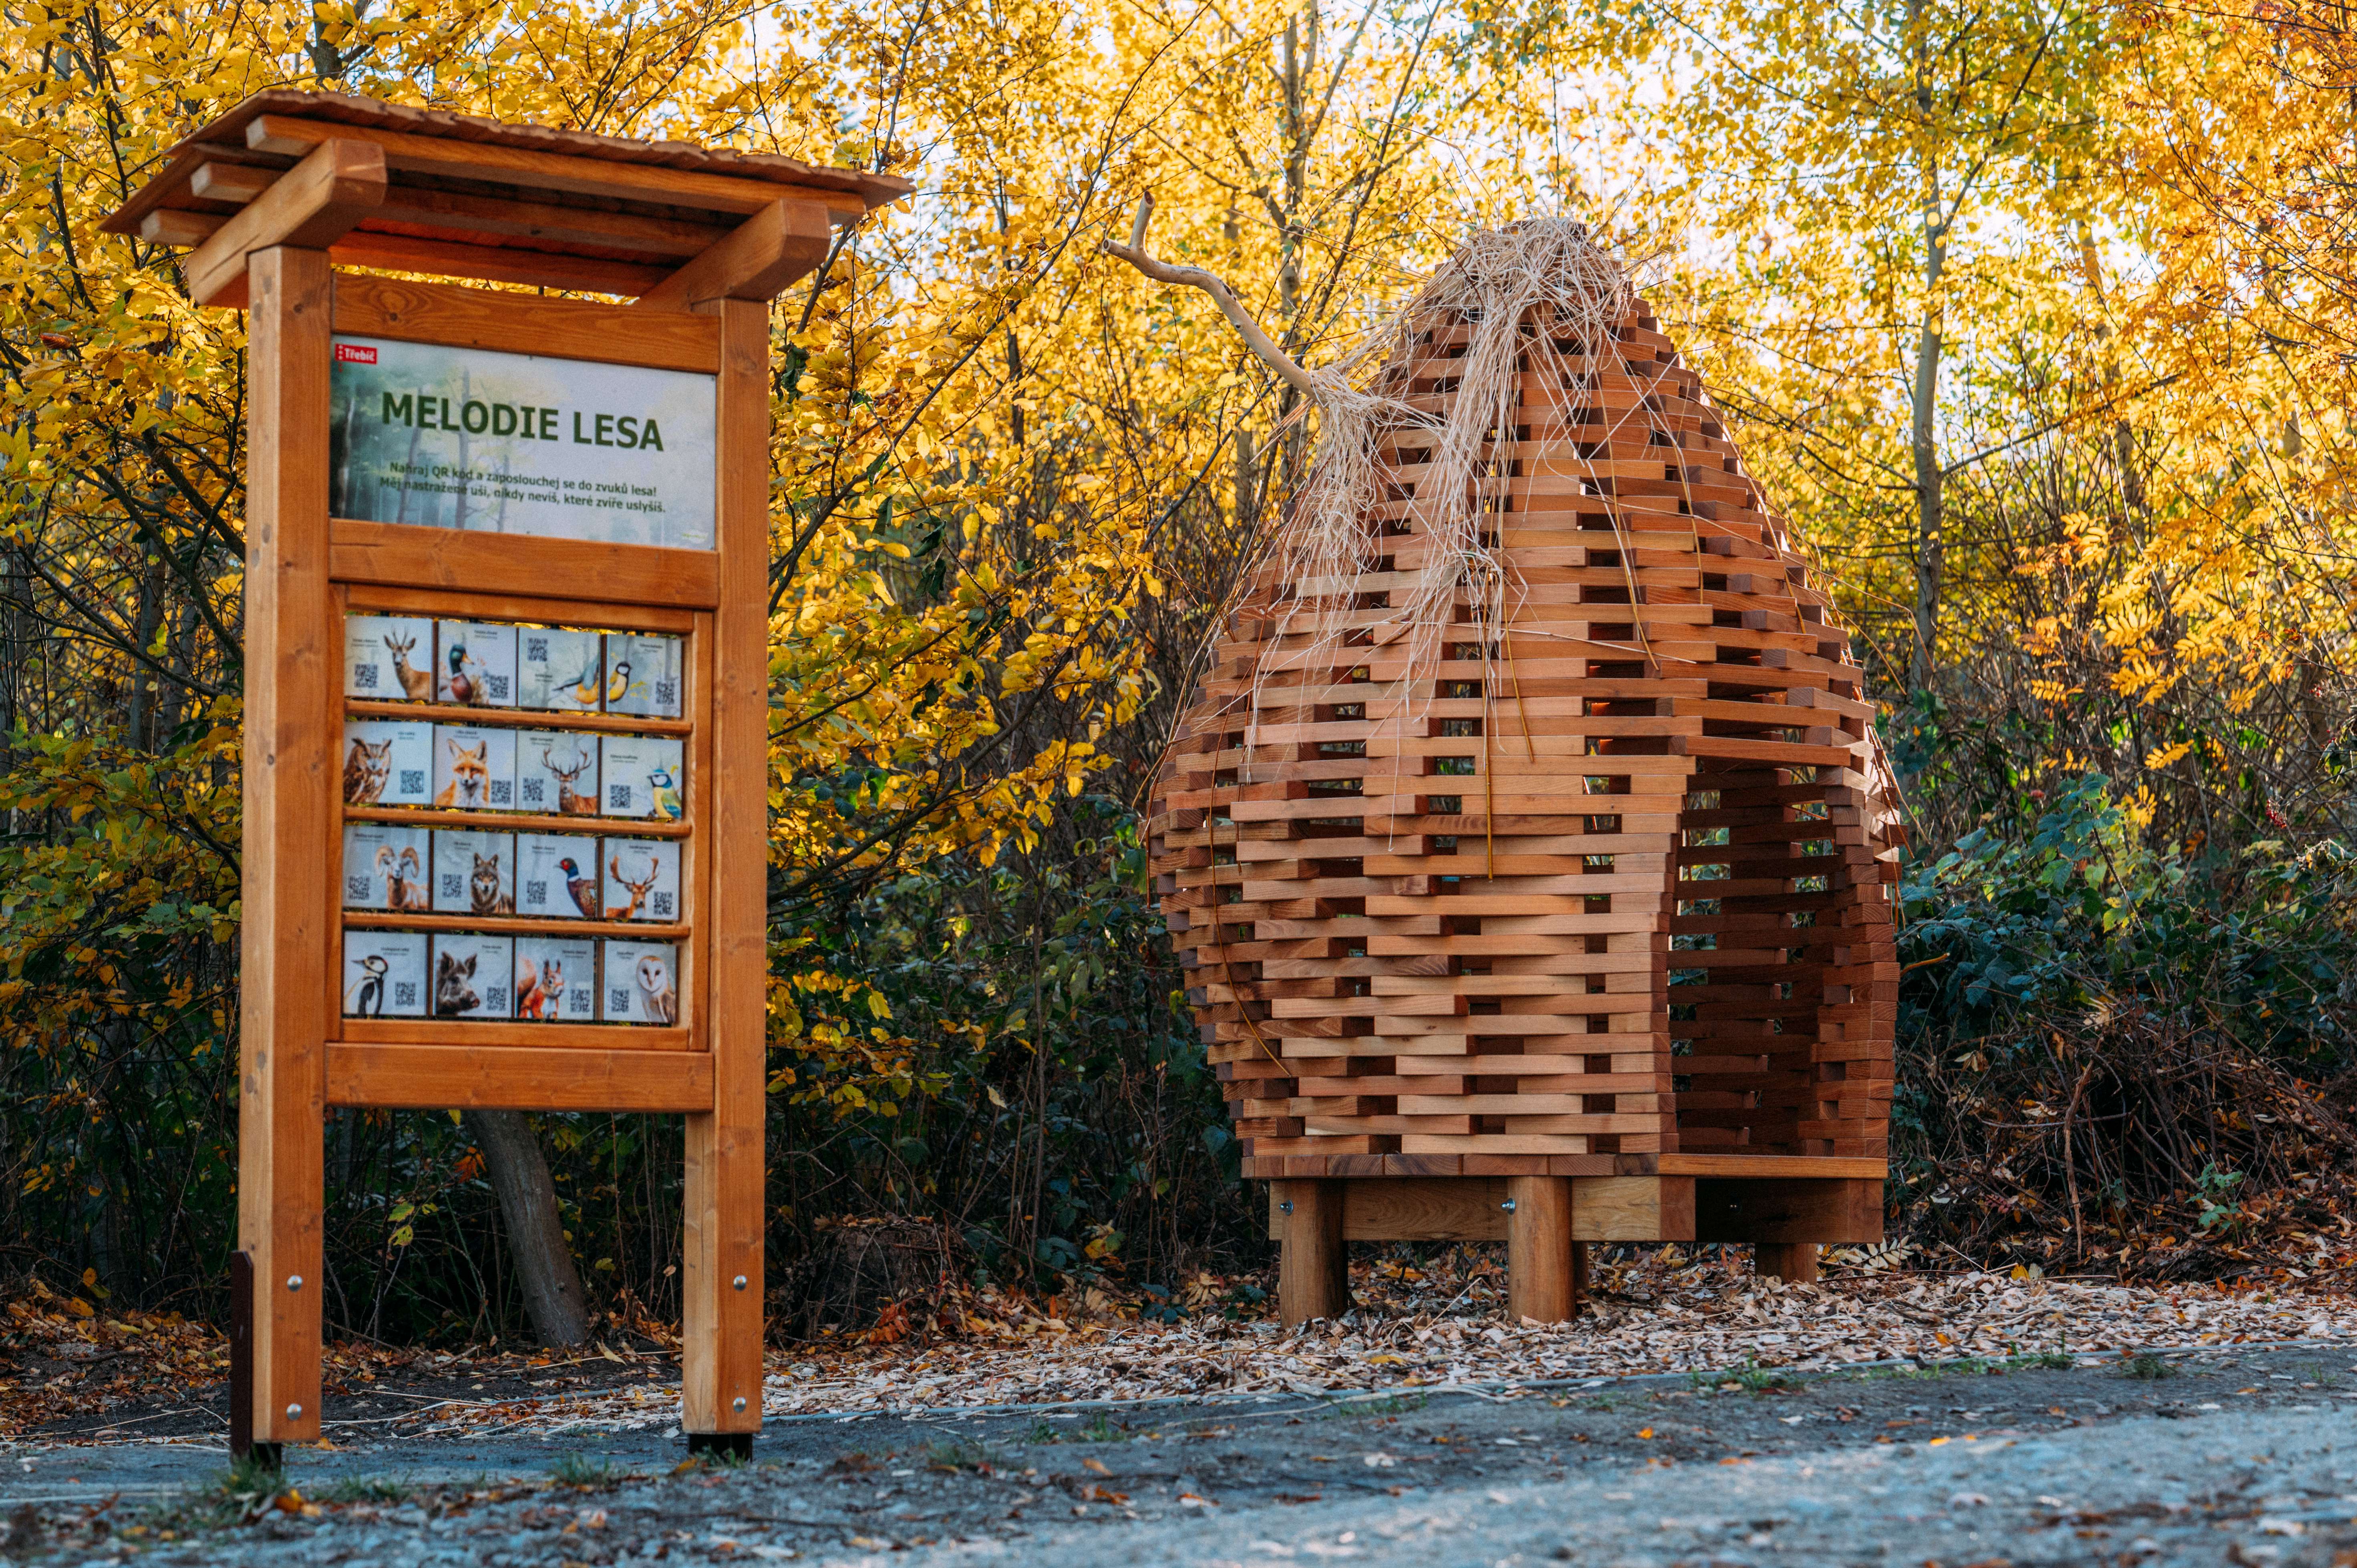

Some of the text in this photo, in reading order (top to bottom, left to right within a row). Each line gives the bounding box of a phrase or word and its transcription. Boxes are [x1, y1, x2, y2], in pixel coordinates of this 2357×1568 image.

[344, 348, 375, 362] Třebíč
[382, 392, 664, 452] MELODIE LESA
[380, 476, 666, 513] Měj nastražené uši, nikdy nevíš, které zvíře uslyšíš.
[390, 462, 429, 478] Nahraj
[431, 466, 448, 478] QR
[452, 467, 473, 479] kód
[486, 472, 560, 490] zaposlouchej
[563, 480, 575, 489] se
[578, 480, 592, 491] do
[595, 482, 628, 494] zvuků
[631, 484, 657, 497] lesa!
